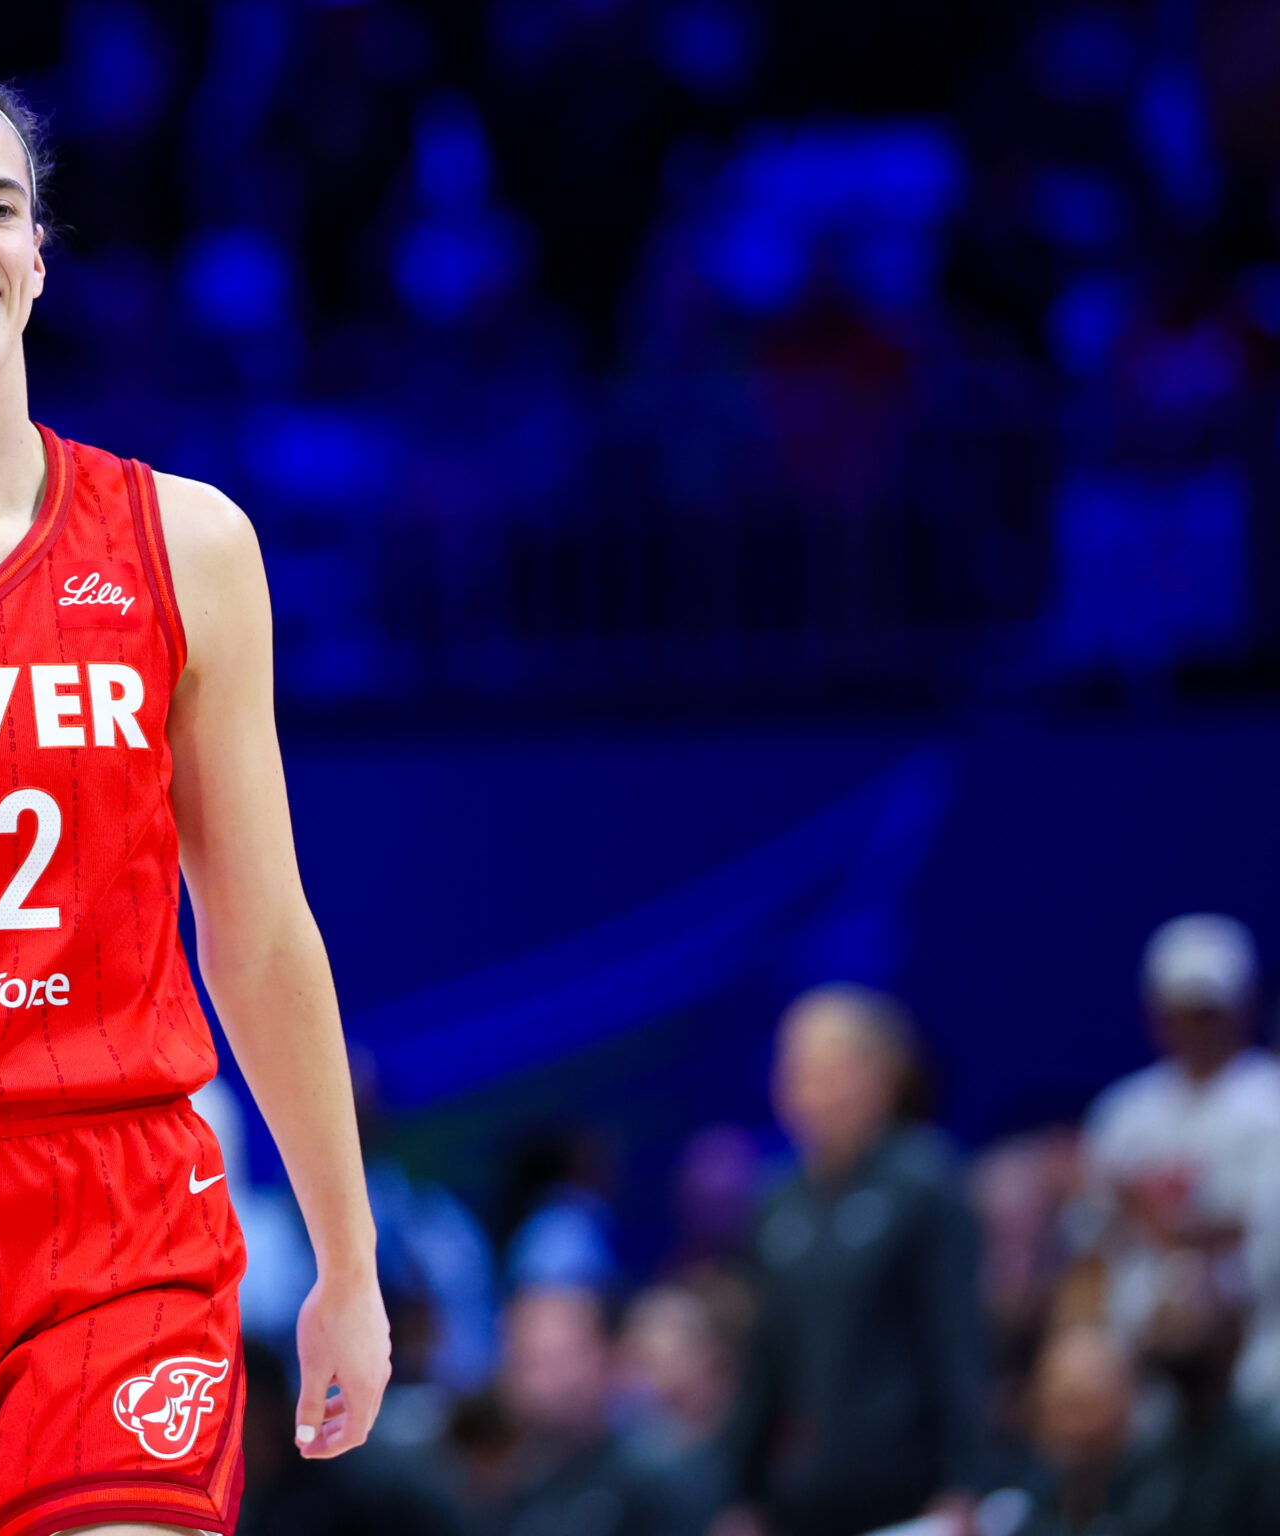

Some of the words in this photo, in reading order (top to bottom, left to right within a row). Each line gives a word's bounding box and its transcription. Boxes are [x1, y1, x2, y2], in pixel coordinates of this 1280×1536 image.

[59, 572, 135, 615] Lilly
[71, 779, 81, 903] BASKETBALL
[41, 1008, 67, 1097] BASKETBA
[51, 1177, 61, 1227] 2012
[155, 1172, 169, 1215] 2020
[50, 1237, 59, 1281] 2020
[152, 1303, 165, 1334] 200
[75, 1317, 95, 1430] BASKETBALL
[73, 1440, 82, 1476] CHO
